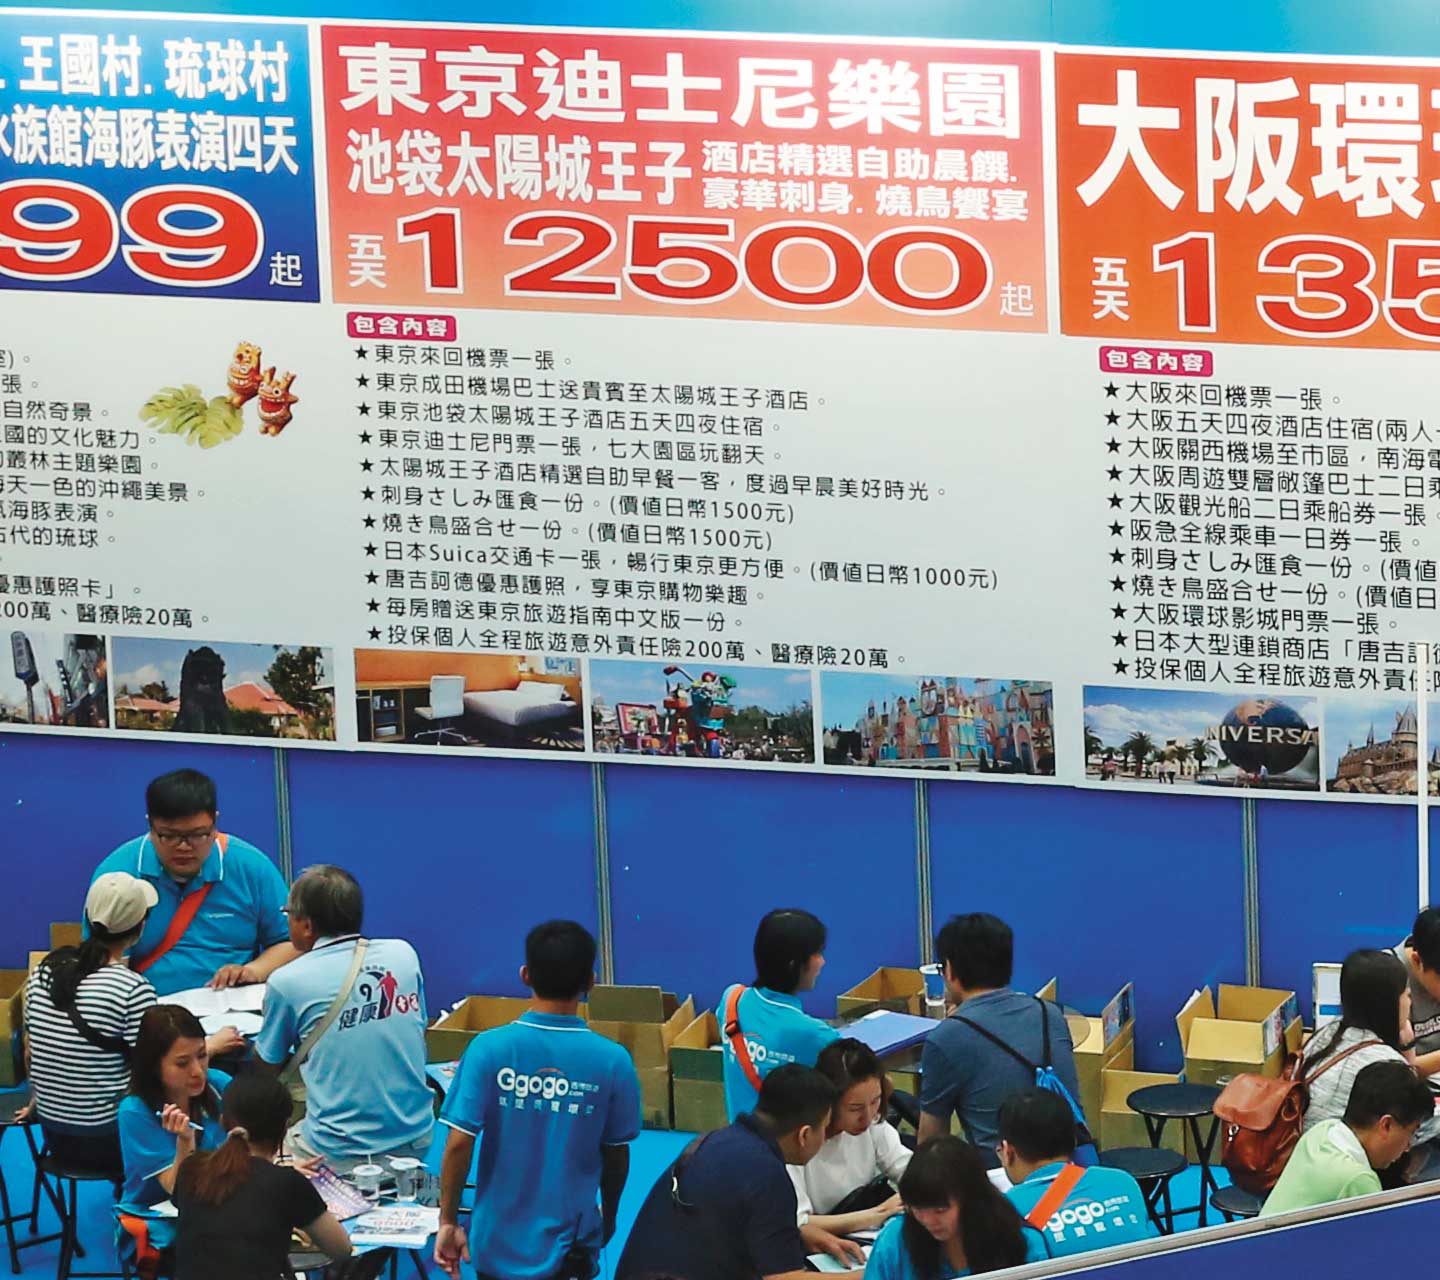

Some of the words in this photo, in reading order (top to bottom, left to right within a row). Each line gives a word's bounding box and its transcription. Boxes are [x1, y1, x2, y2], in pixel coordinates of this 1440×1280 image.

[337, 41, 1021, 139] 東京迪士尼樂園
[345, 127, 693, 207] 池袋太陽城王子
[875, 185, 1029, 222] 燒鳥饗宴
[268, 251, 304, 287] 起
[397, 205, 994, 316] 12500
[998, 282, 1035, 318] 起
[353, 314, 449, 339] 包含內容
[1106, 347, 1206, 374] 包含內容
[497, 1067, 569, 1100] Ggogo
